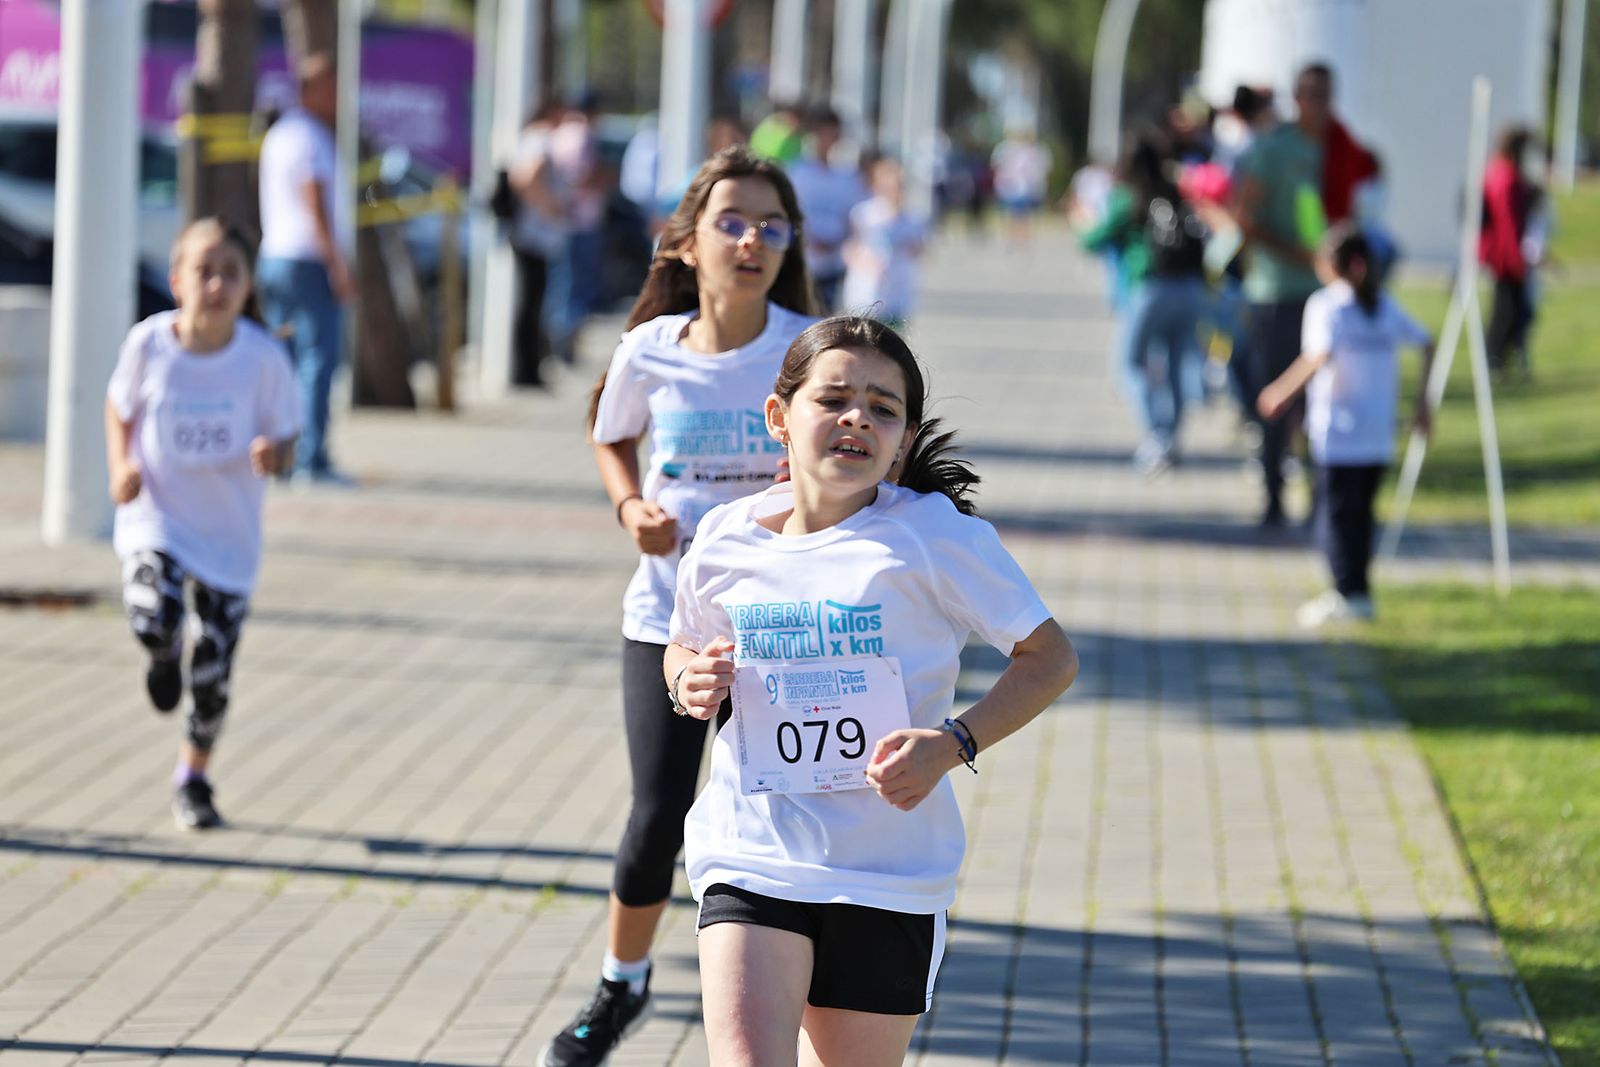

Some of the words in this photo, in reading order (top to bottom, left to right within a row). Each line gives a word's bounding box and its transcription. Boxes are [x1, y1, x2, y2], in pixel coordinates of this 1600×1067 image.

[725, 602, 815, 630] ARRERA
[828, 612, 882, 634] kilos
[738, 631, 819, 660] FANTIL
[830, 640, 842, 656] x
[849, 636, 883, 656] km
[783, 671, 835, 684] CARRERA
[841, 673, 865, 684] kilos
[784, 684, 836, 698] INFANTIL
[842, 687, 849, 695] x
[851, 684, 867, 694] km
[777, 717, 867, 764] 079
